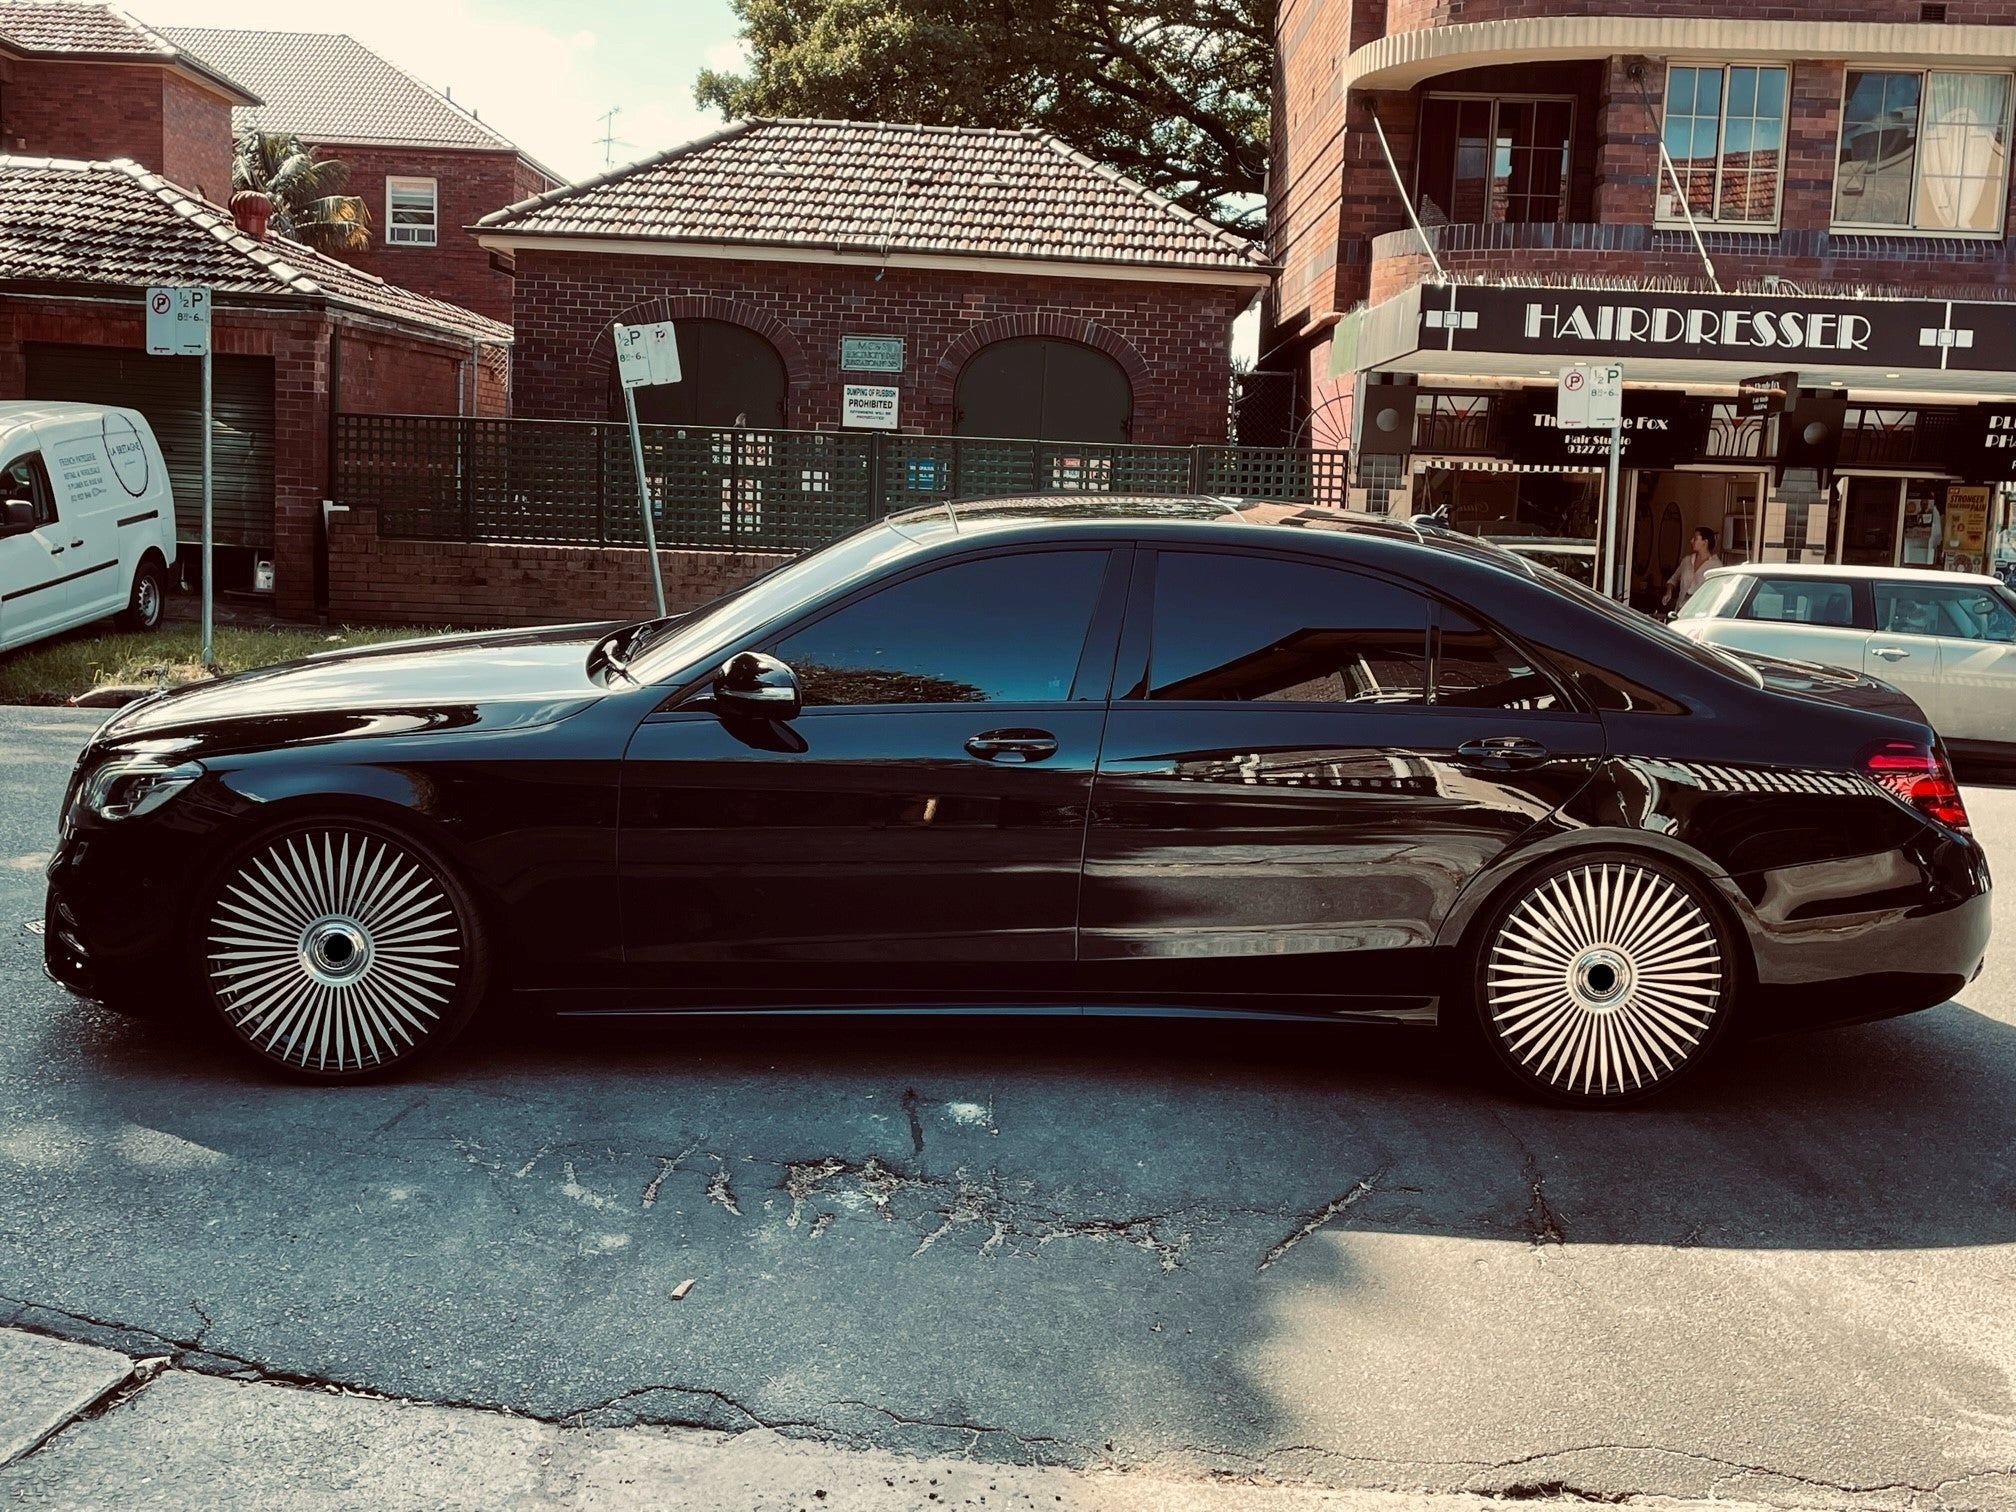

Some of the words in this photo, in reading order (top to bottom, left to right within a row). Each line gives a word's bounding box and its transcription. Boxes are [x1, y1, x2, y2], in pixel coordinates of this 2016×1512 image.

[1524, 303, 1871, 350] HAIRDRESSER
[848, 399, 893, 409] PROHIBITED
[1533, 413, 1557, 427] Th
[1636, 416, 1669, 430] Fox
[1564, 434, 1591, 444] Hair
[1593, 435, 1632, 446] Stuio
